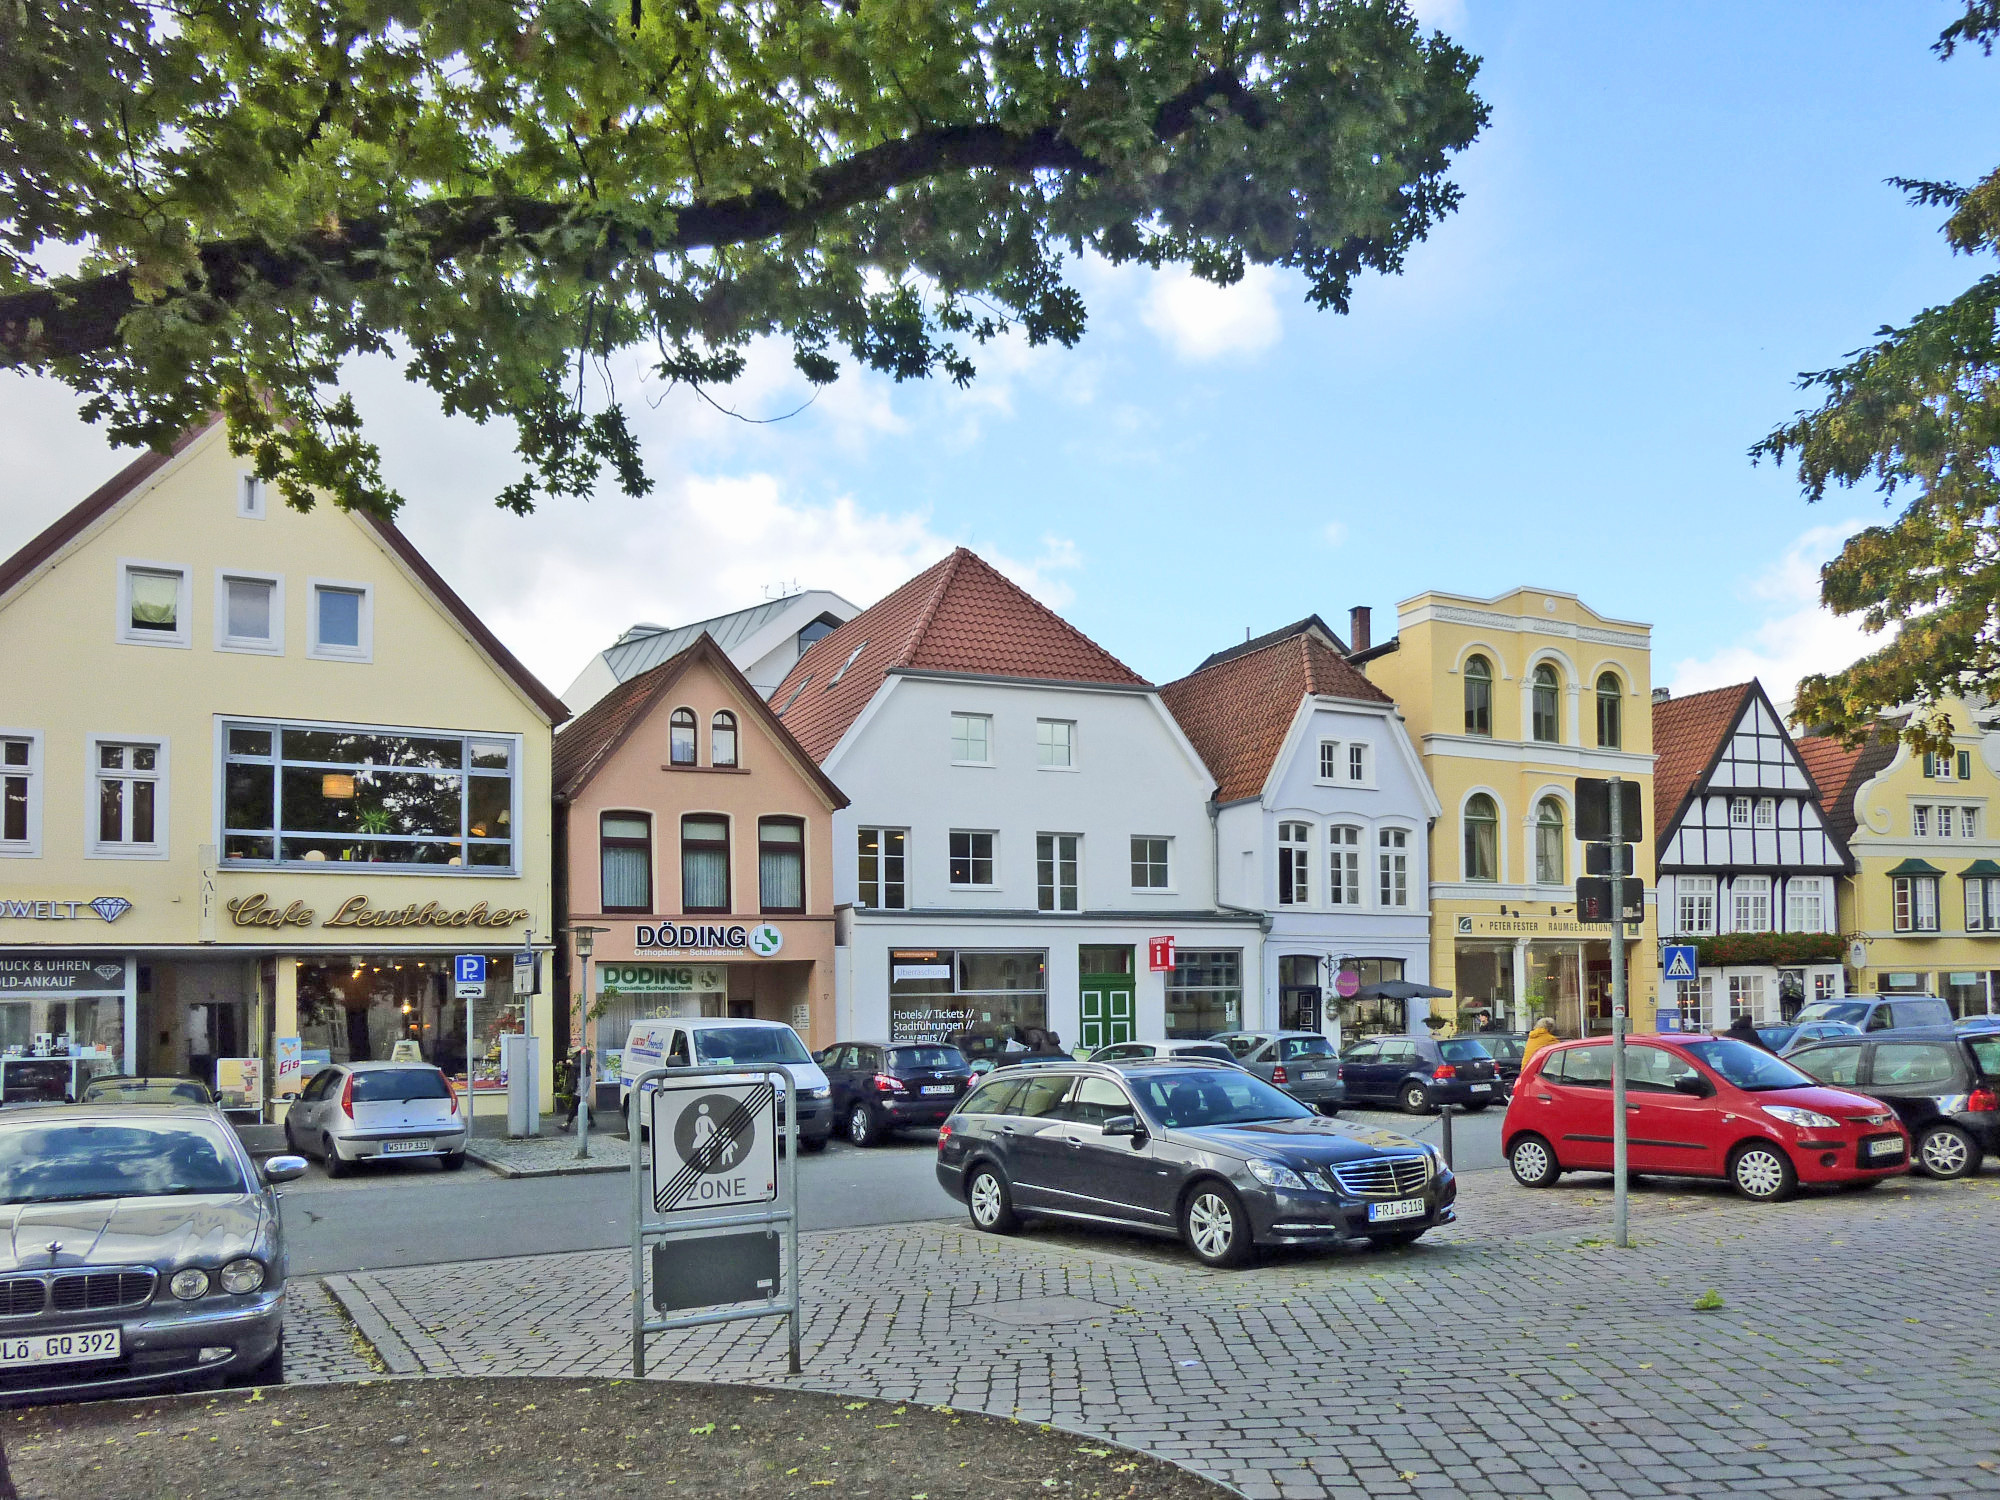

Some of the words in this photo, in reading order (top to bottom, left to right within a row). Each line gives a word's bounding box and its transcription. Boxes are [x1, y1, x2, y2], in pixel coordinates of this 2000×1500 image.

[322, 894, 530, 928] Leutbecher
[1489, 921, 1512, 931] PETER
[1513, 921, 1539, 931] FESTER
[635, 921, 747, 948] DÖDING
[634, 949, 681, 958] Orthopädie
[689, 949, 744, 957] Schuhtechnik
[0, 960, 31, 971] UCK
[46, 960, 91, 971] UHREN
[897, 967, 948, 978] Überraschung
[0, 976, 77, 987] LD-ANKAUF
[893, 1009, 923, 1020] Hotels
[934, 1008, 965, 1019] Tickets
[893, 1021, 964, 1032] Stadtführungen
[279, 1059, 300, 1076] Eis
[388, 1142, 403, 1151] WST
[686, 1177, 747, 1202] ZONE
[1375, 1203, 1395, 1217] FRI
[1408, 1199, 1423, 1213] 118
[0, 1340, 29, 1360] LÖ
[46, 1336, 72, 1357] GQ
[78, 1332, 116, 1353] 392
